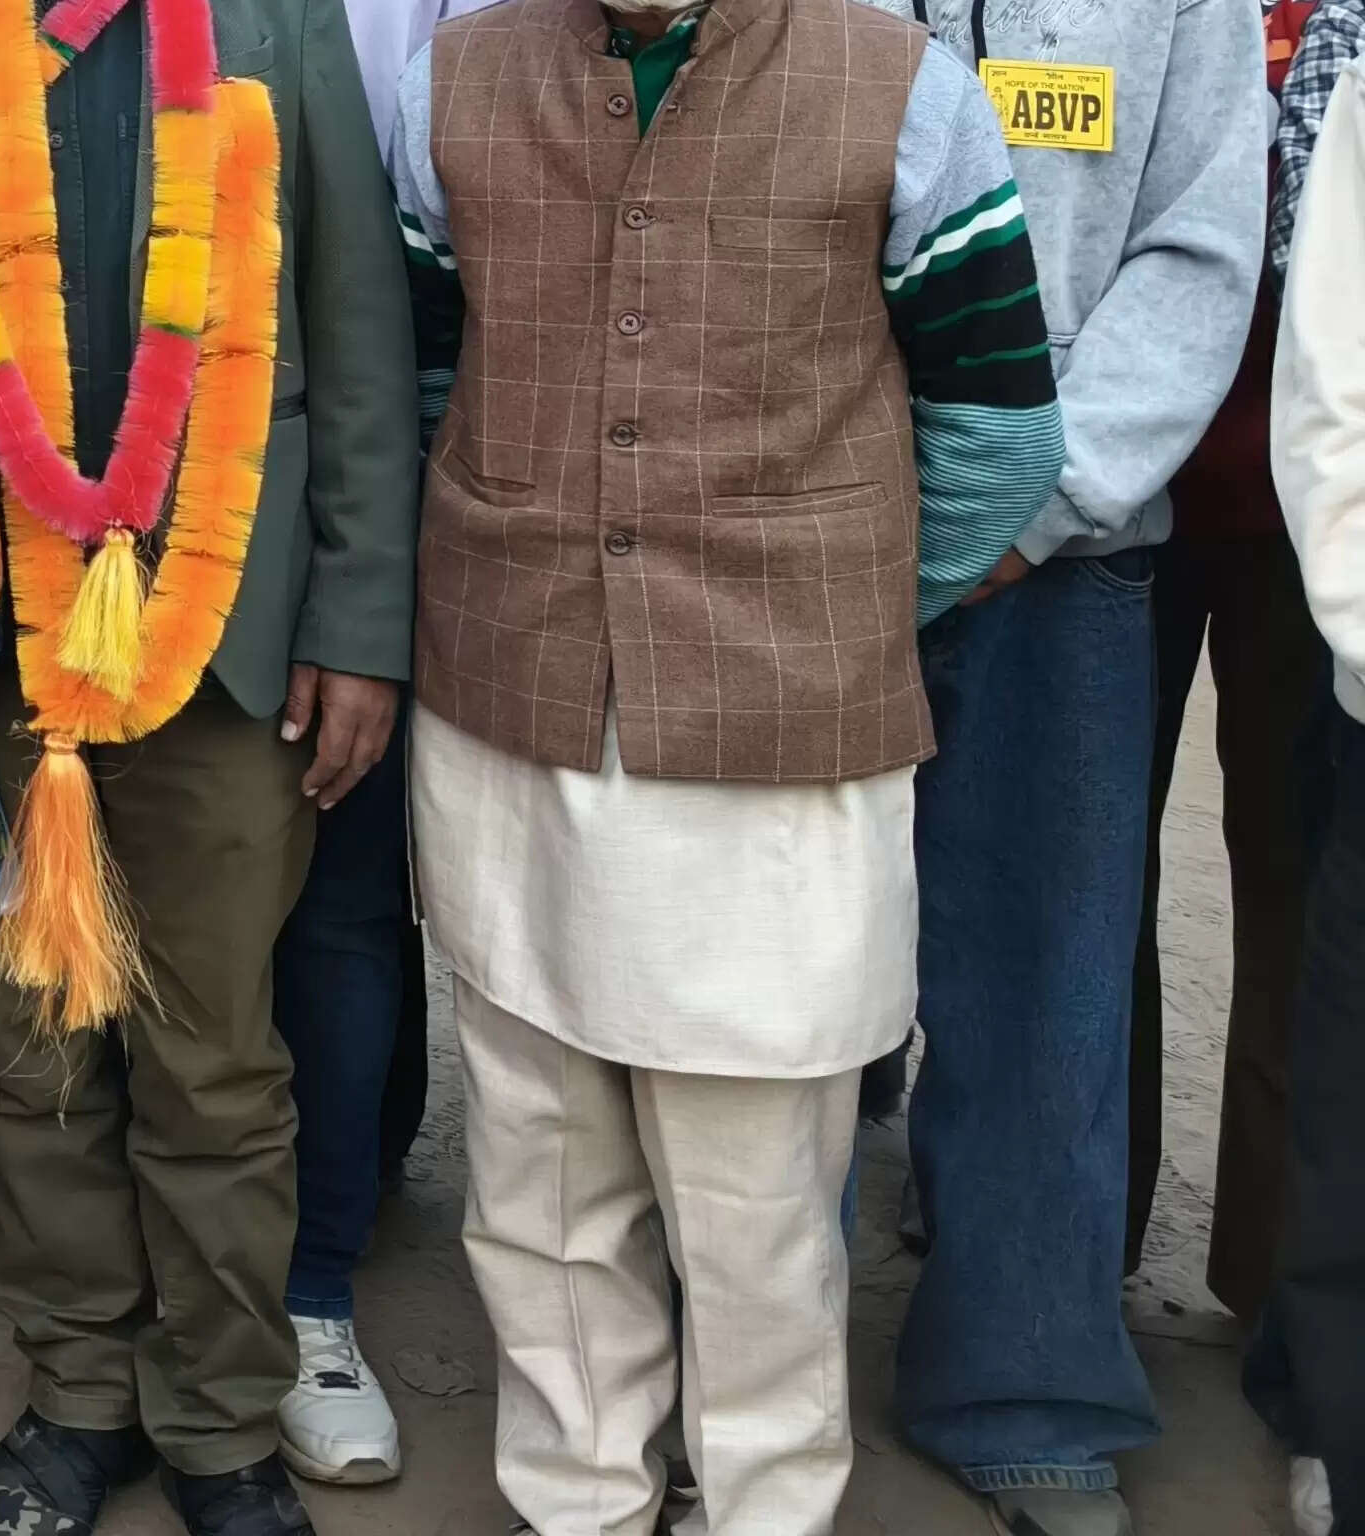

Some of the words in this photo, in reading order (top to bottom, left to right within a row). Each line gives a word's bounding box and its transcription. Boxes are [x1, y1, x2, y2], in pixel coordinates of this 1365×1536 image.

[1004, 80, 1027, 89] HOPE
[1057, 83, 1085, 92] NATION
[1011, 90, 1101, 133] ABVP
